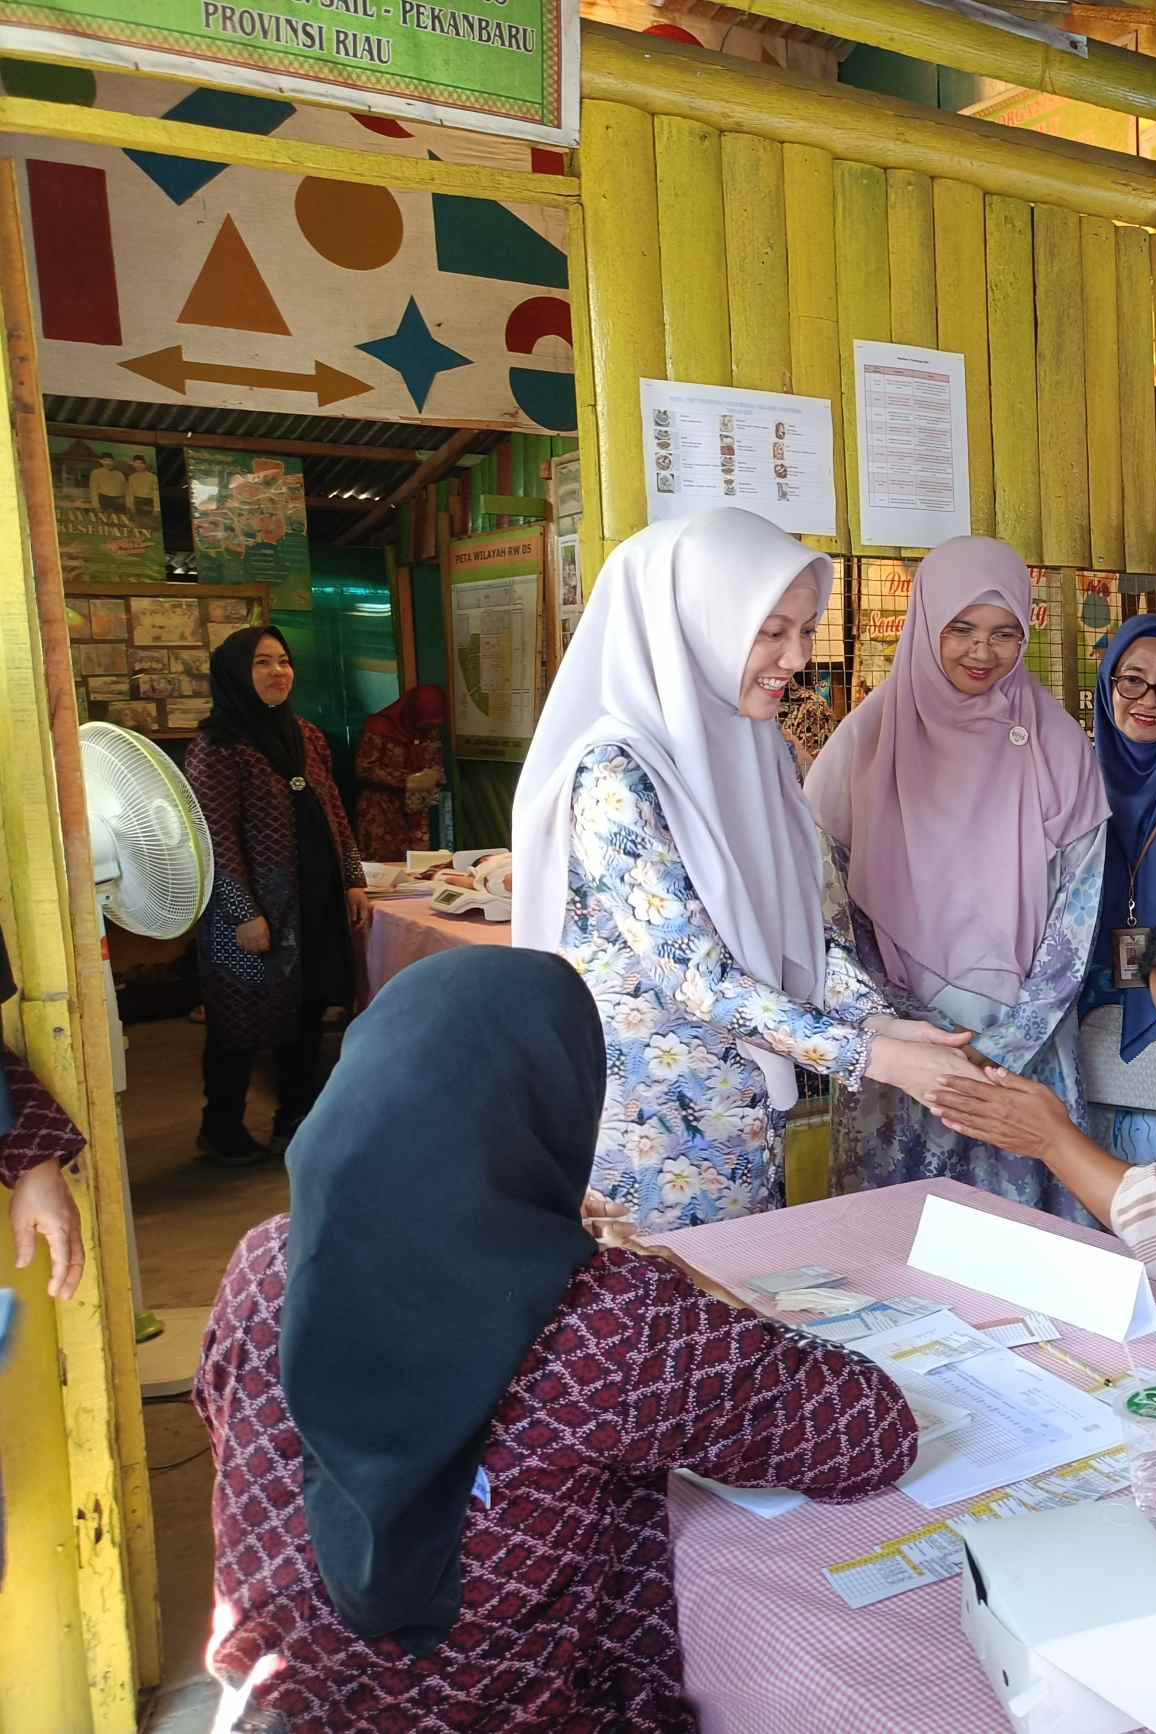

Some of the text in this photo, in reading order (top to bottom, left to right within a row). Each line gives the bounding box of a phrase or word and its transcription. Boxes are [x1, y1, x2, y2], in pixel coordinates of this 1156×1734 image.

[202, 2, 393, 65] PROVINSI RIAU
[401, 1, 537, 53] PEKANBARU
